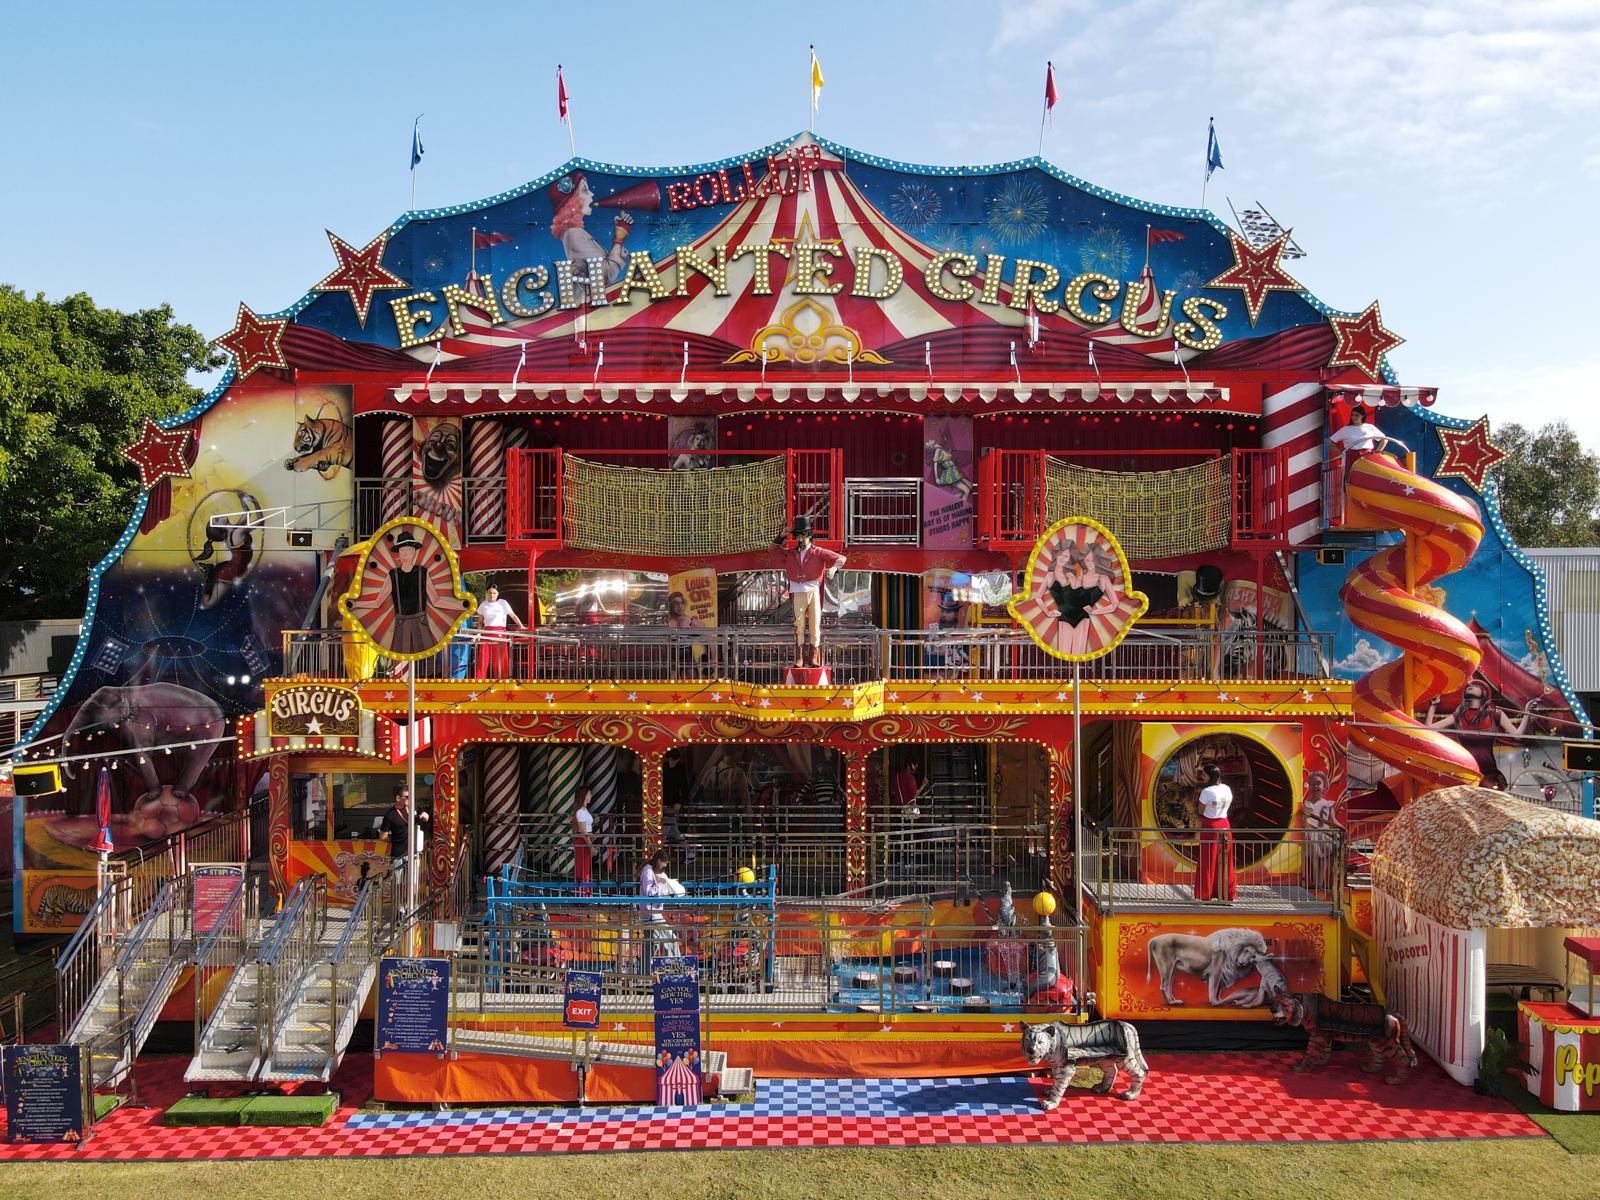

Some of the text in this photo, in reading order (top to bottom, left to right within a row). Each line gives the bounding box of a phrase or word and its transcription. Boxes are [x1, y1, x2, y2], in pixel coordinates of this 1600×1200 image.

[668, 144, 821, 212] ROLL UP
[387, 244, 1229, 352] ENCHANTED CIRCUS
[928, 517, 970, 536] OTHERS HAPPY
[943, 513, 950, 522] OF
[1225, 588, 1272, 609] ASHTN
[274, 691, 355, 722] CIRCUS
[1387, 944, 1428, 964] Popcorn
[390, 967, 437, 977] ENCHANTED
[661, 986, 677, 994] CAN
[572, 1007, 592, 1016] EXIT
[17, 1055, 66, 1065] ENCHANTED
